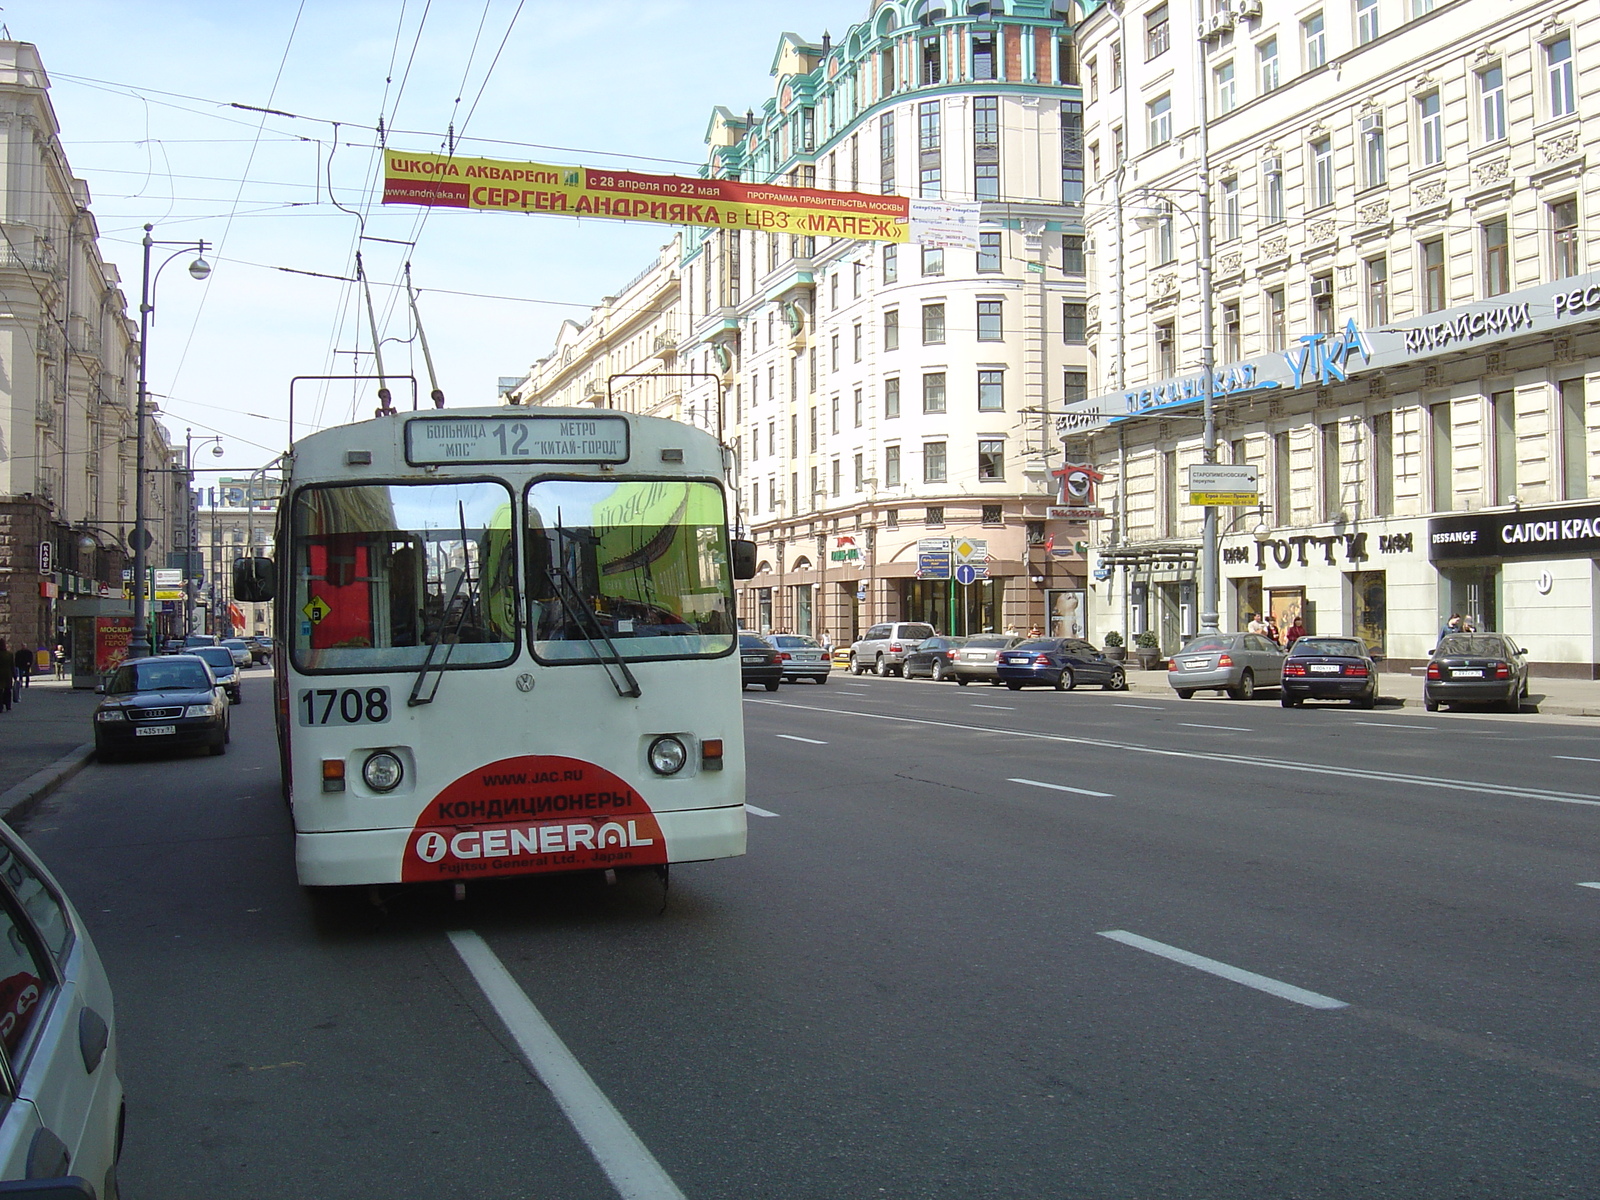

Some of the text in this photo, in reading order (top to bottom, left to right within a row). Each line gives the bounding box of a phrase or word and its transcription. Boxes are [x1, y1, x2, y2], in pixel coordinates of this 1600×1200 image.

[391, 158, 559, 185] ШКОЛА АКВАРЕЛИ
[600, 176, 615, 187] 28
[618, 179, 660, 192] апреля
[663, 184, 678, 193] по
[680, 184, 695, 194] 22
[698, 187, 720, 196] мая
[472, 186, 567, 212] СЕРГЕЙ
[574, 195, 721, 224] АНДРИЯКА
[745, 208, 789, 229] ЦВЗ
[747, 191, 904, 212] ПРОГРАММА ПРАВИТЕЛЬСТВА МОСКВЫ
[1284, 318, 1374, 390] УТКА
[1551, 283, 1600, 320] РЕС
[426, 424, 486, 440] БОЛЬНИЦА
[492, 423, 530, 456] 12
[560, 421, 597, 437] МЕТРО
[1432, 531, 1478, 544] DESSANGE
[1502, 521, 1557, 543] САЛОН
[302, 688, 389, 725] 1708
[483, 770, 583, 786] WWW.JAC.RU
[439, 791, 632, 819] КОНДИЦИОНЕРЫ
[451, 821, 653, 859] GENERAL
[439, 861, 487, 874] Fujitsu
[493, 857, 548, 868] General
[590, 850, 632, 863] Japan
